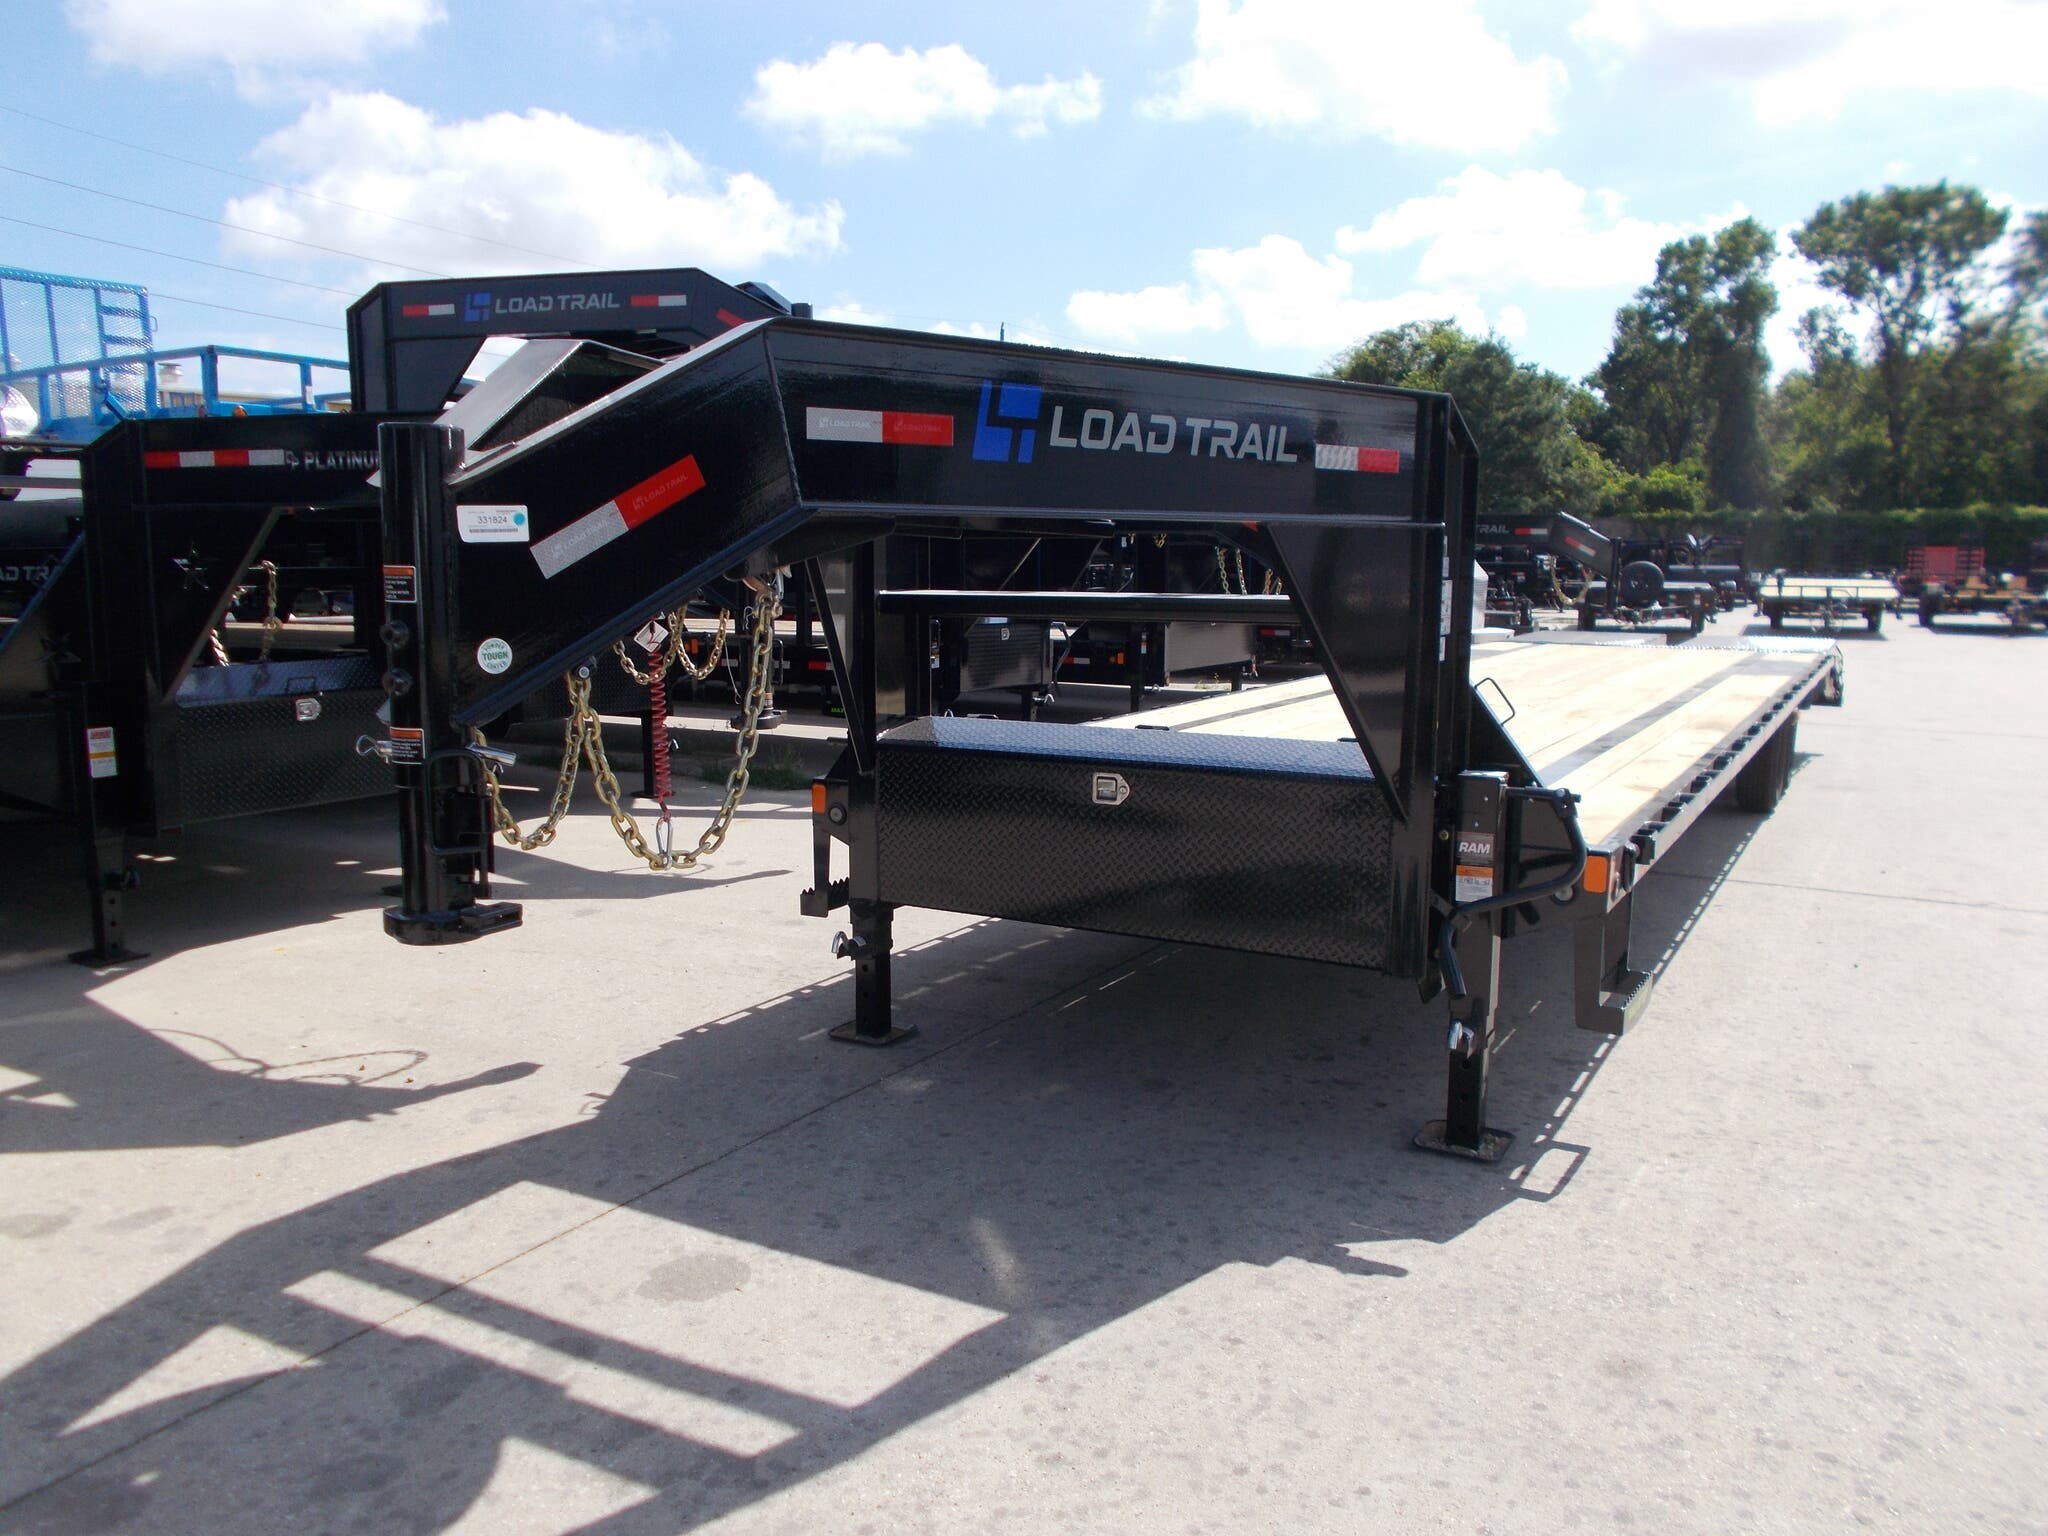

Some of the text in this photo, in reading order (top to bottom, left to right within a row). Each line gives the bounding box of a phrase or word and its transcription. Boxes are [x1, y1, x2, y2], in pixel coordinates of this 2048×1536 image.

[495, 293, 620, 314] LOAD TRAIL
[1050, 405, 1177, 454] LOAD
[1185, 418, 1298, 463] TRAIL
[477, 515, 508, 525] 331824
[1459, 842, 1491, 854] RAM
